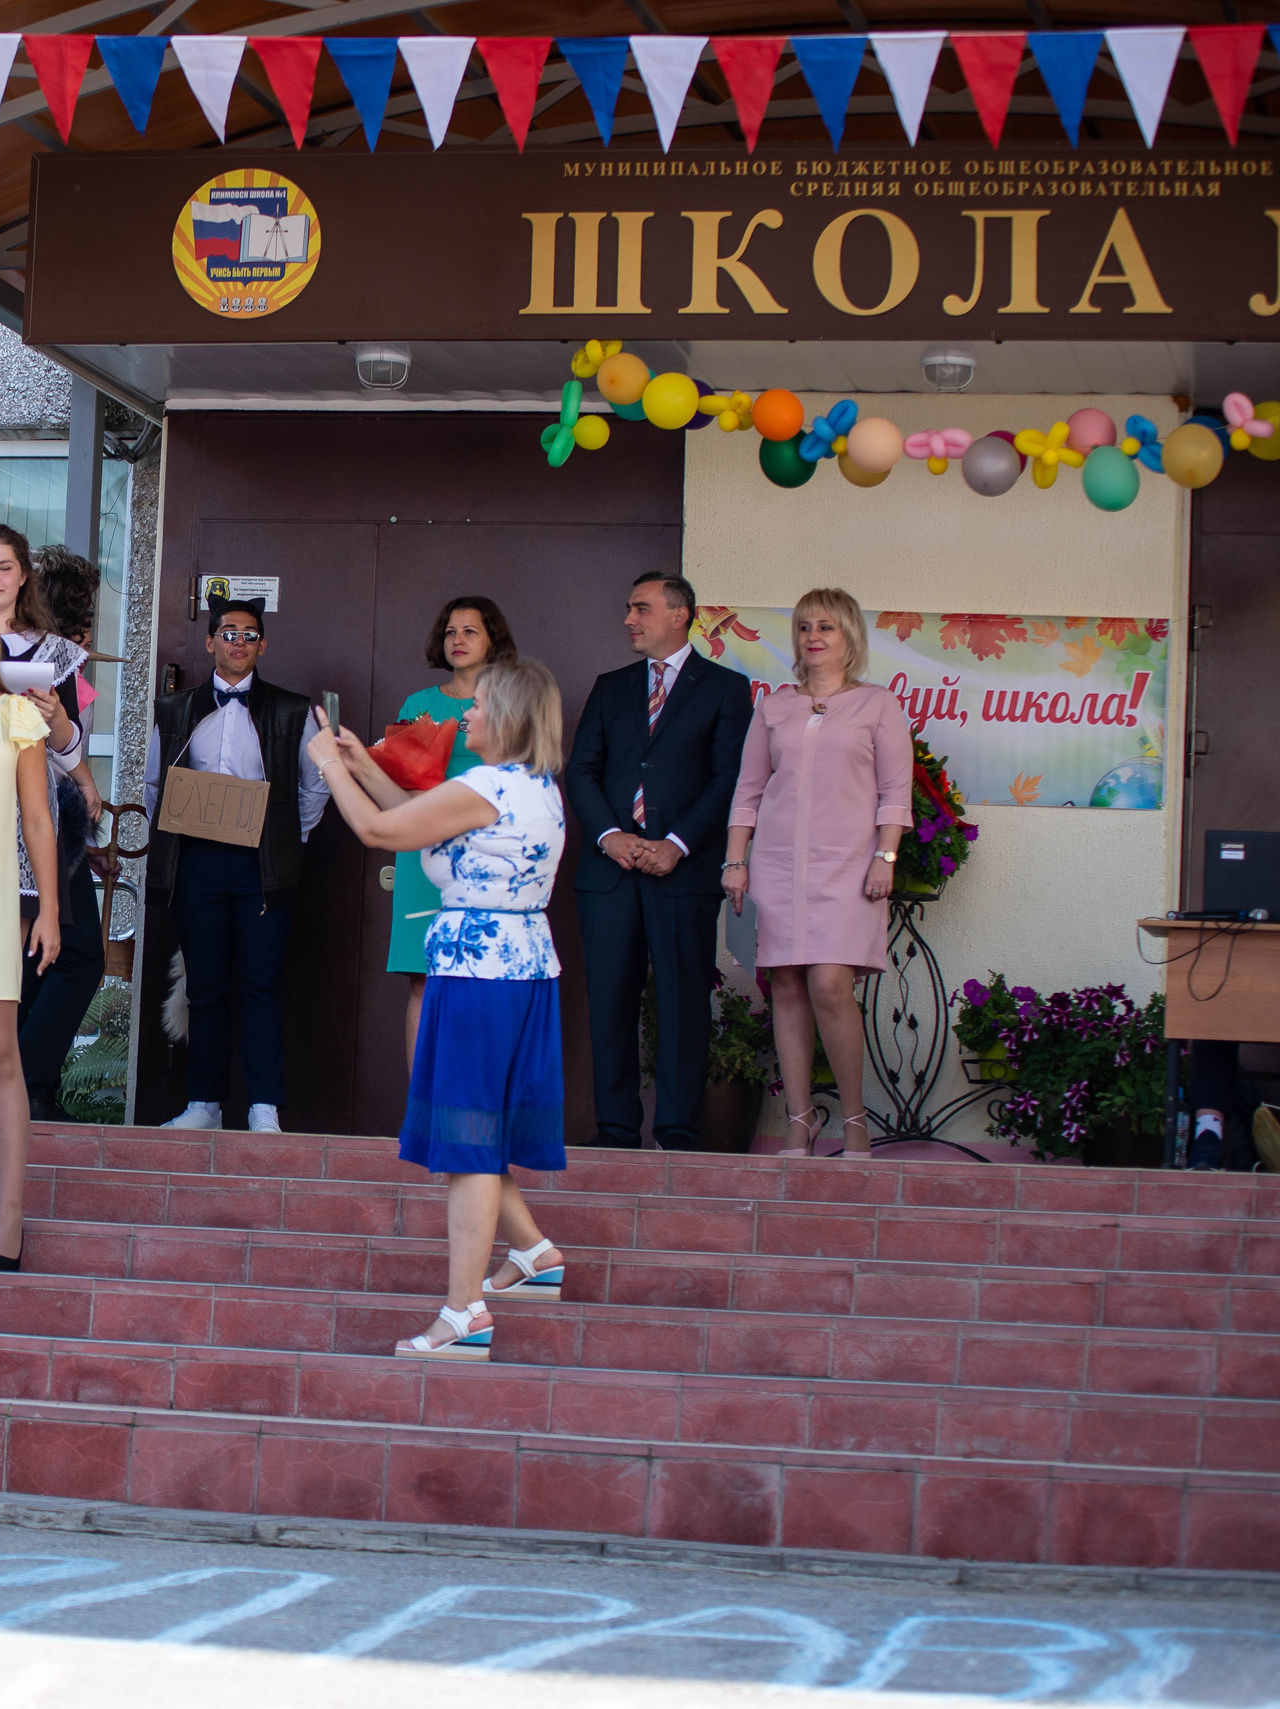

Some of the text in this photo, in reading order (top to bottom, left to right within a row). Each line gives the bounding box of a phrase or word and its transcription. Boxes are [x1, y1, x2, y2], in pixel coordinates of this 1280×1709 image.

[564, 159, 1274, 177] МУНИЦИПАЛЬНОЕ БЮДЖЕТНОЕ ОБЩЕОБРАЗОВАТЕЛЬНОЕ
[210, 190, 249, 200] КЛИМОВСК
[249, 190, 275, 199] ШКОЛА
[790, 180, 1222, 198] СРЕДНЯЯ ОБЩЕОБРАЗОВАТЕЛЬНАЯ
[519, 205, 1175, 316] ШКОЛА
[210, 266, 281, 278] УЧИСЬ БЫТЬ ПЕРВЫМ
[981, 672, 1152, 728] школа!
